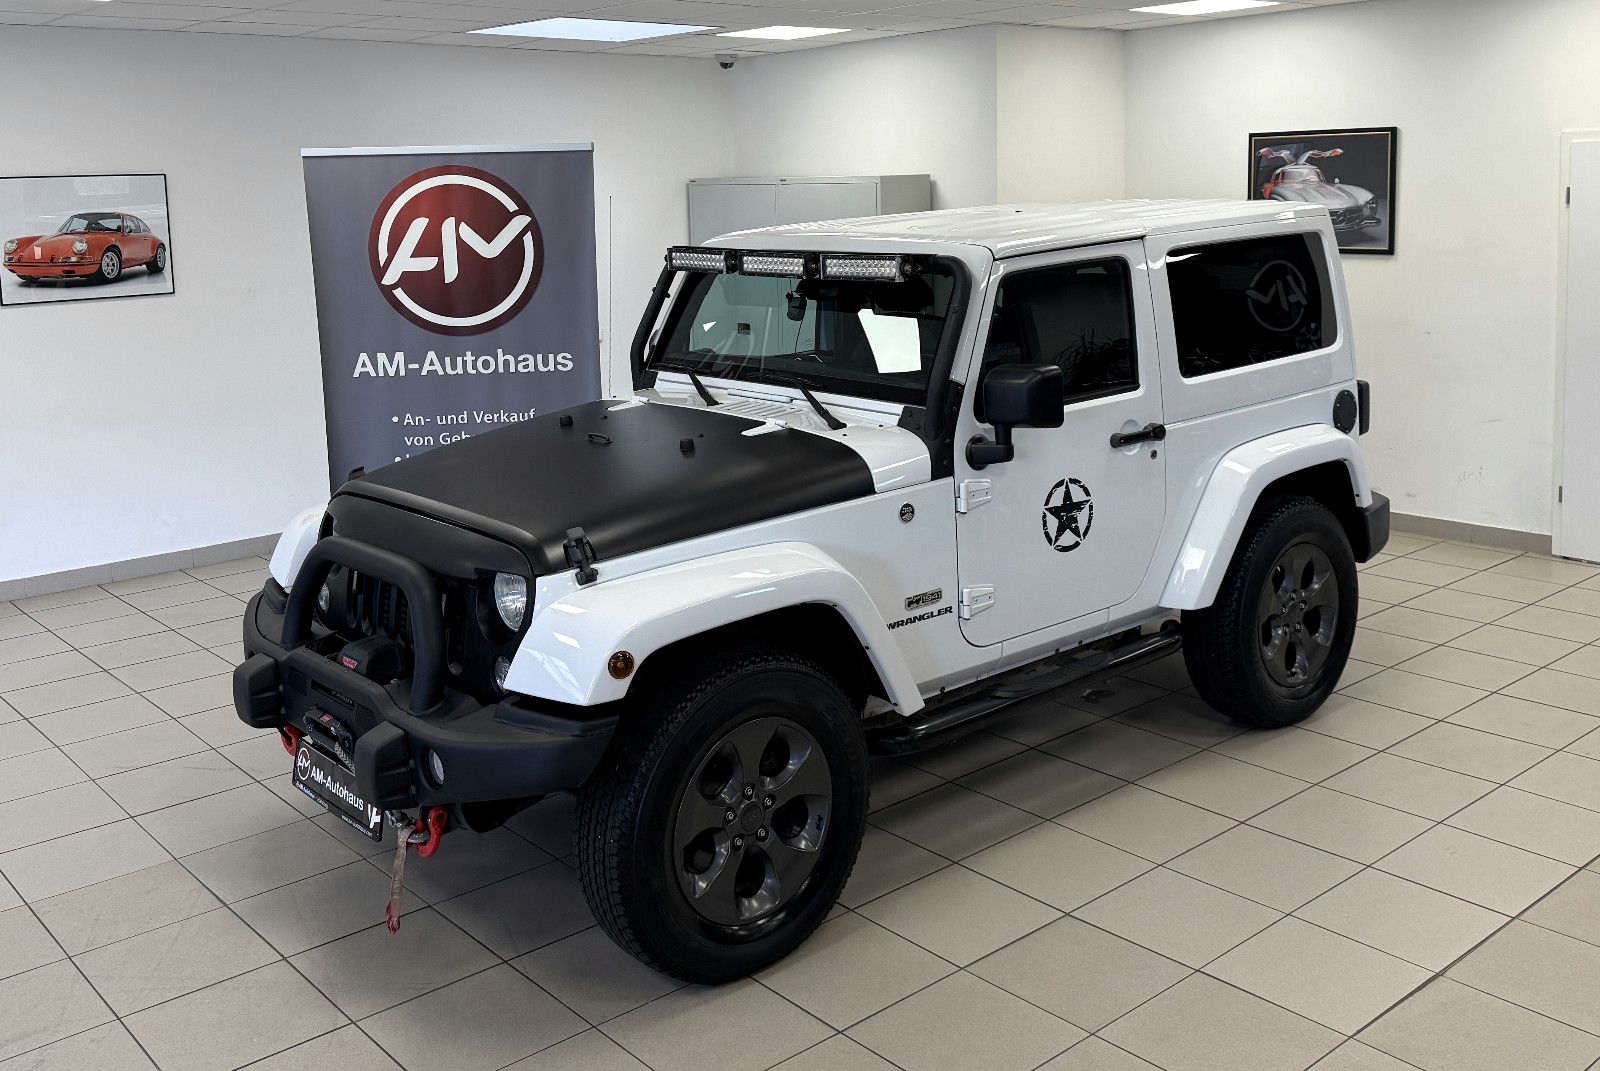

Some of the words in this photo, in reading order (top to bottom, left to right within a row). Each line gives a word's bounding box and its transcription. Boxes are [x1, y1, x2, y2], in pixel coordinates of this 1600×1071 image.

[352, 349, 574, 378] AM-Autohaus
[403, 413, 431, 426] An-
[436, 411, 468, 425] und
[473, 408, 536, 423] Verkauf
[404, 435, 434, 446] von
[921, 590, 942, 603] 1941
[887, 605, 953, 631] WRANGLER
[310, 765, 364, 811] AM-Autohaus
